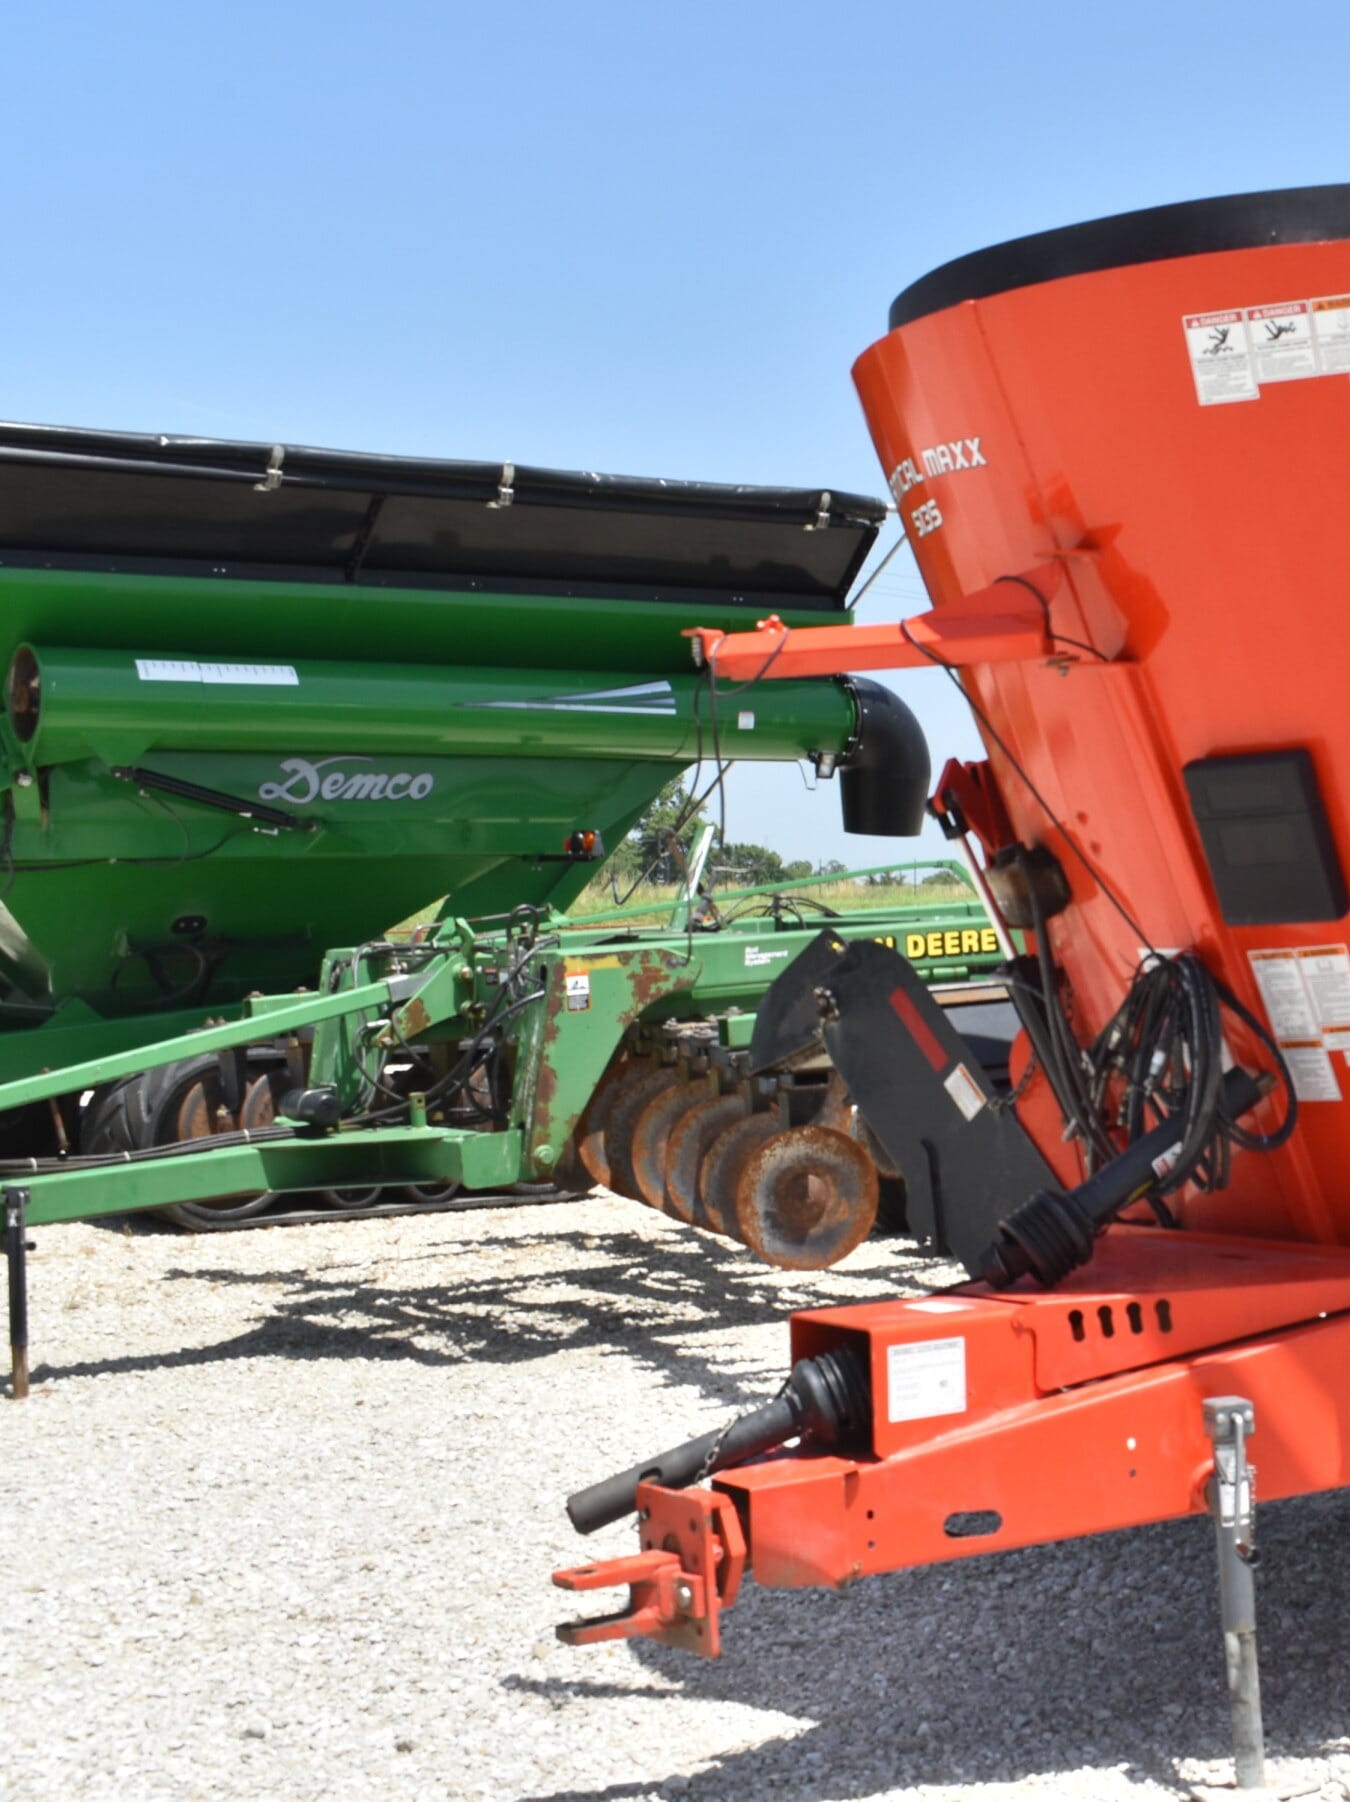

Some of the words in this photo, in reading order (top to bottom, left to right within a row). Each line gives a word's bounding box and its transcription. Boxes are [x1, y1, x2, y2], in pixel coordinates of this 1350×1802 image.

[921, 436, 987, 478] MAXX
[258, 755, 435, 804] Demco
[906, 927, 997, 959] DEERE
